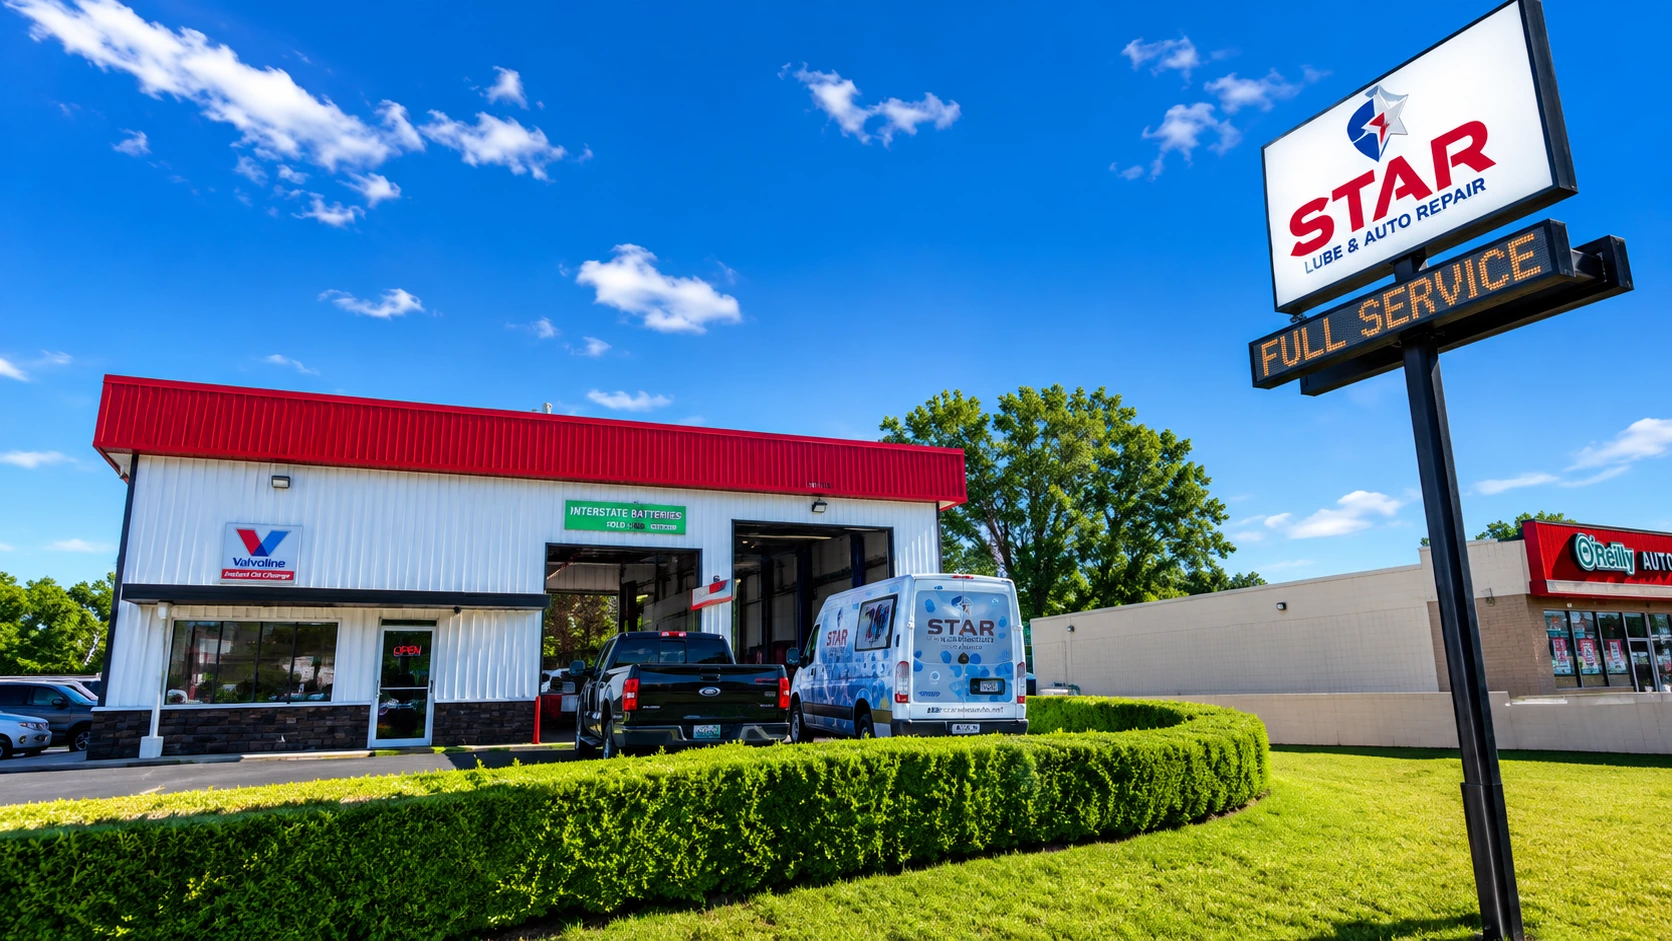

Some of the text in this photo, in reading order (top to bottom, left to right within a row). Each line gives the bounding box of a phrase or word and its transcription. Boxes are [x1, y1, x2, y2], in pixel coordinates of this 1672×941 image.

[1289, 120, 1497, 257] STAR
[1304, 177, 1487, 274] LUBE & AUTO REPAIR
[1260, 233, 1542, 376] FULL SERVICE
[570, 506, 628, 518] INTERSTATE
[232, 557, 286, 568] Valvoline
[1575, 532, 1635, 576] O'Reilly
[826, 628, 848, 647] STAR
[927, 618, 995, 636] STAR
